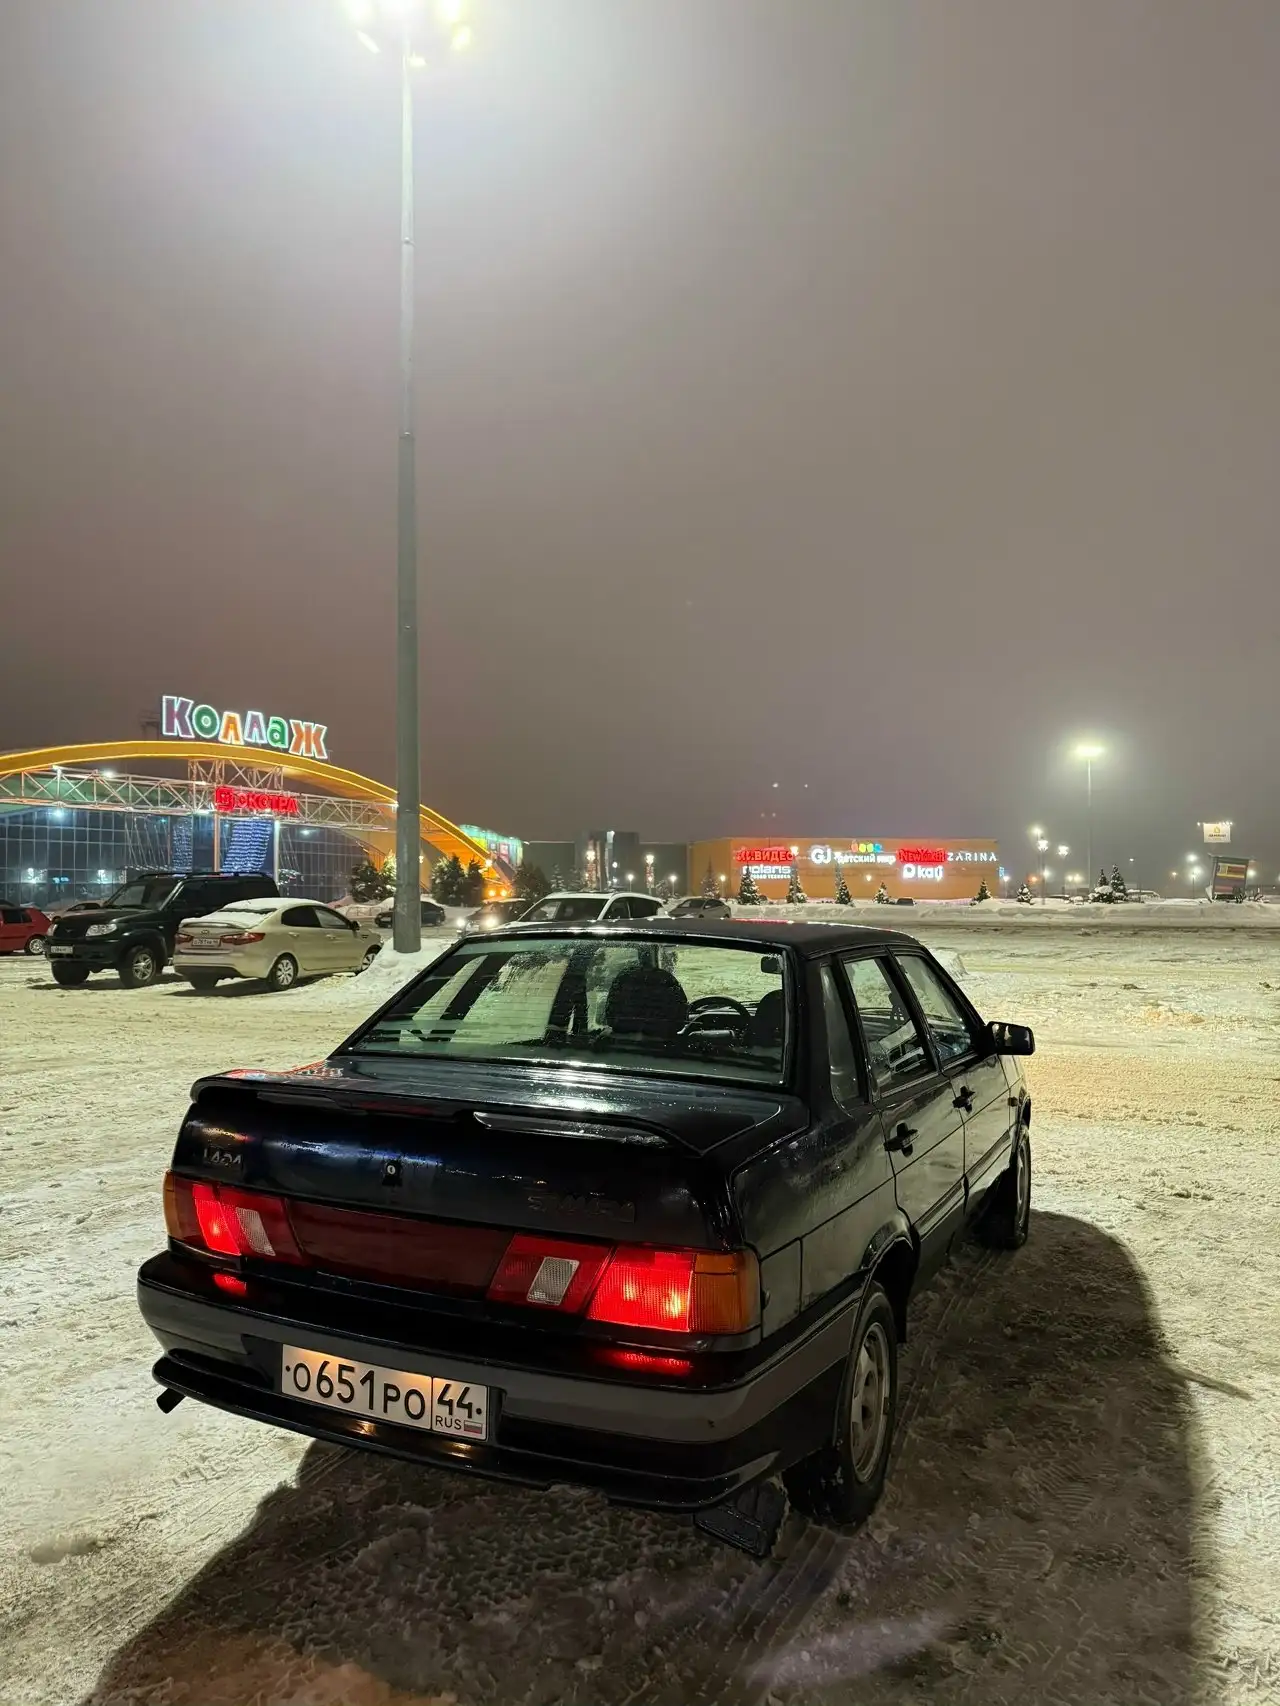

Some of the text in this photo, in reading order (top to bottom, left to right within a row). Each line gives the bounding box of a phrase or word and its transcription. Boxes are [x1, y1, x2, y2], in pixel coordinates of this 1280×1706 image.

[811, 848, 832, 864] GJ
[947, 852, 997, 861] ZARINA
[293, 1360, 473, 1420] О651РО 44
[435, 1416, 462, 1430] RUS
